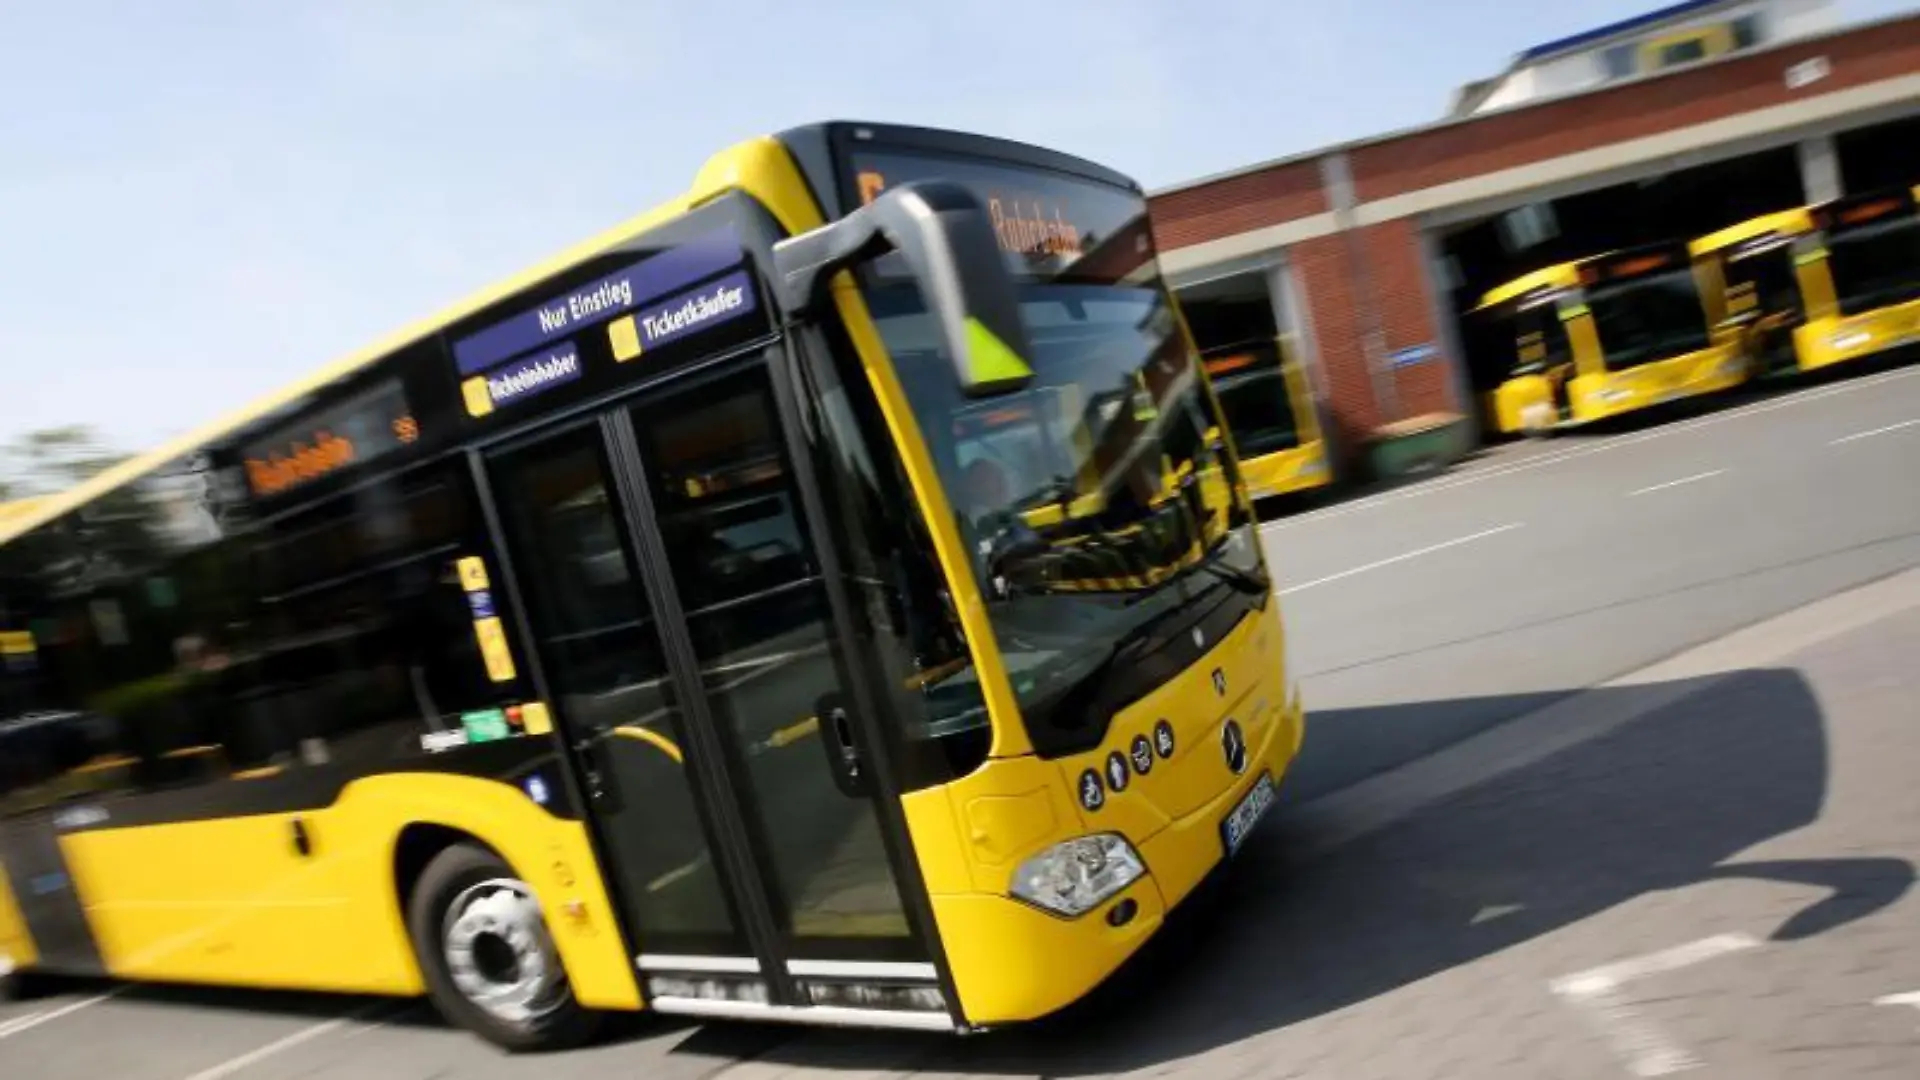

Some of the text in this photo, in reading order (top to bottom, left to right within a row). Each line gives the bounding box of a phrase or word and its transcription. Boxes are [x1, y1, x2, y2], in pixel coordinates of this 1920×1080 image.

[538, 278, 633, 335] Nur Einstieg
[642, 285, 744, 341] Ticketkäufer
